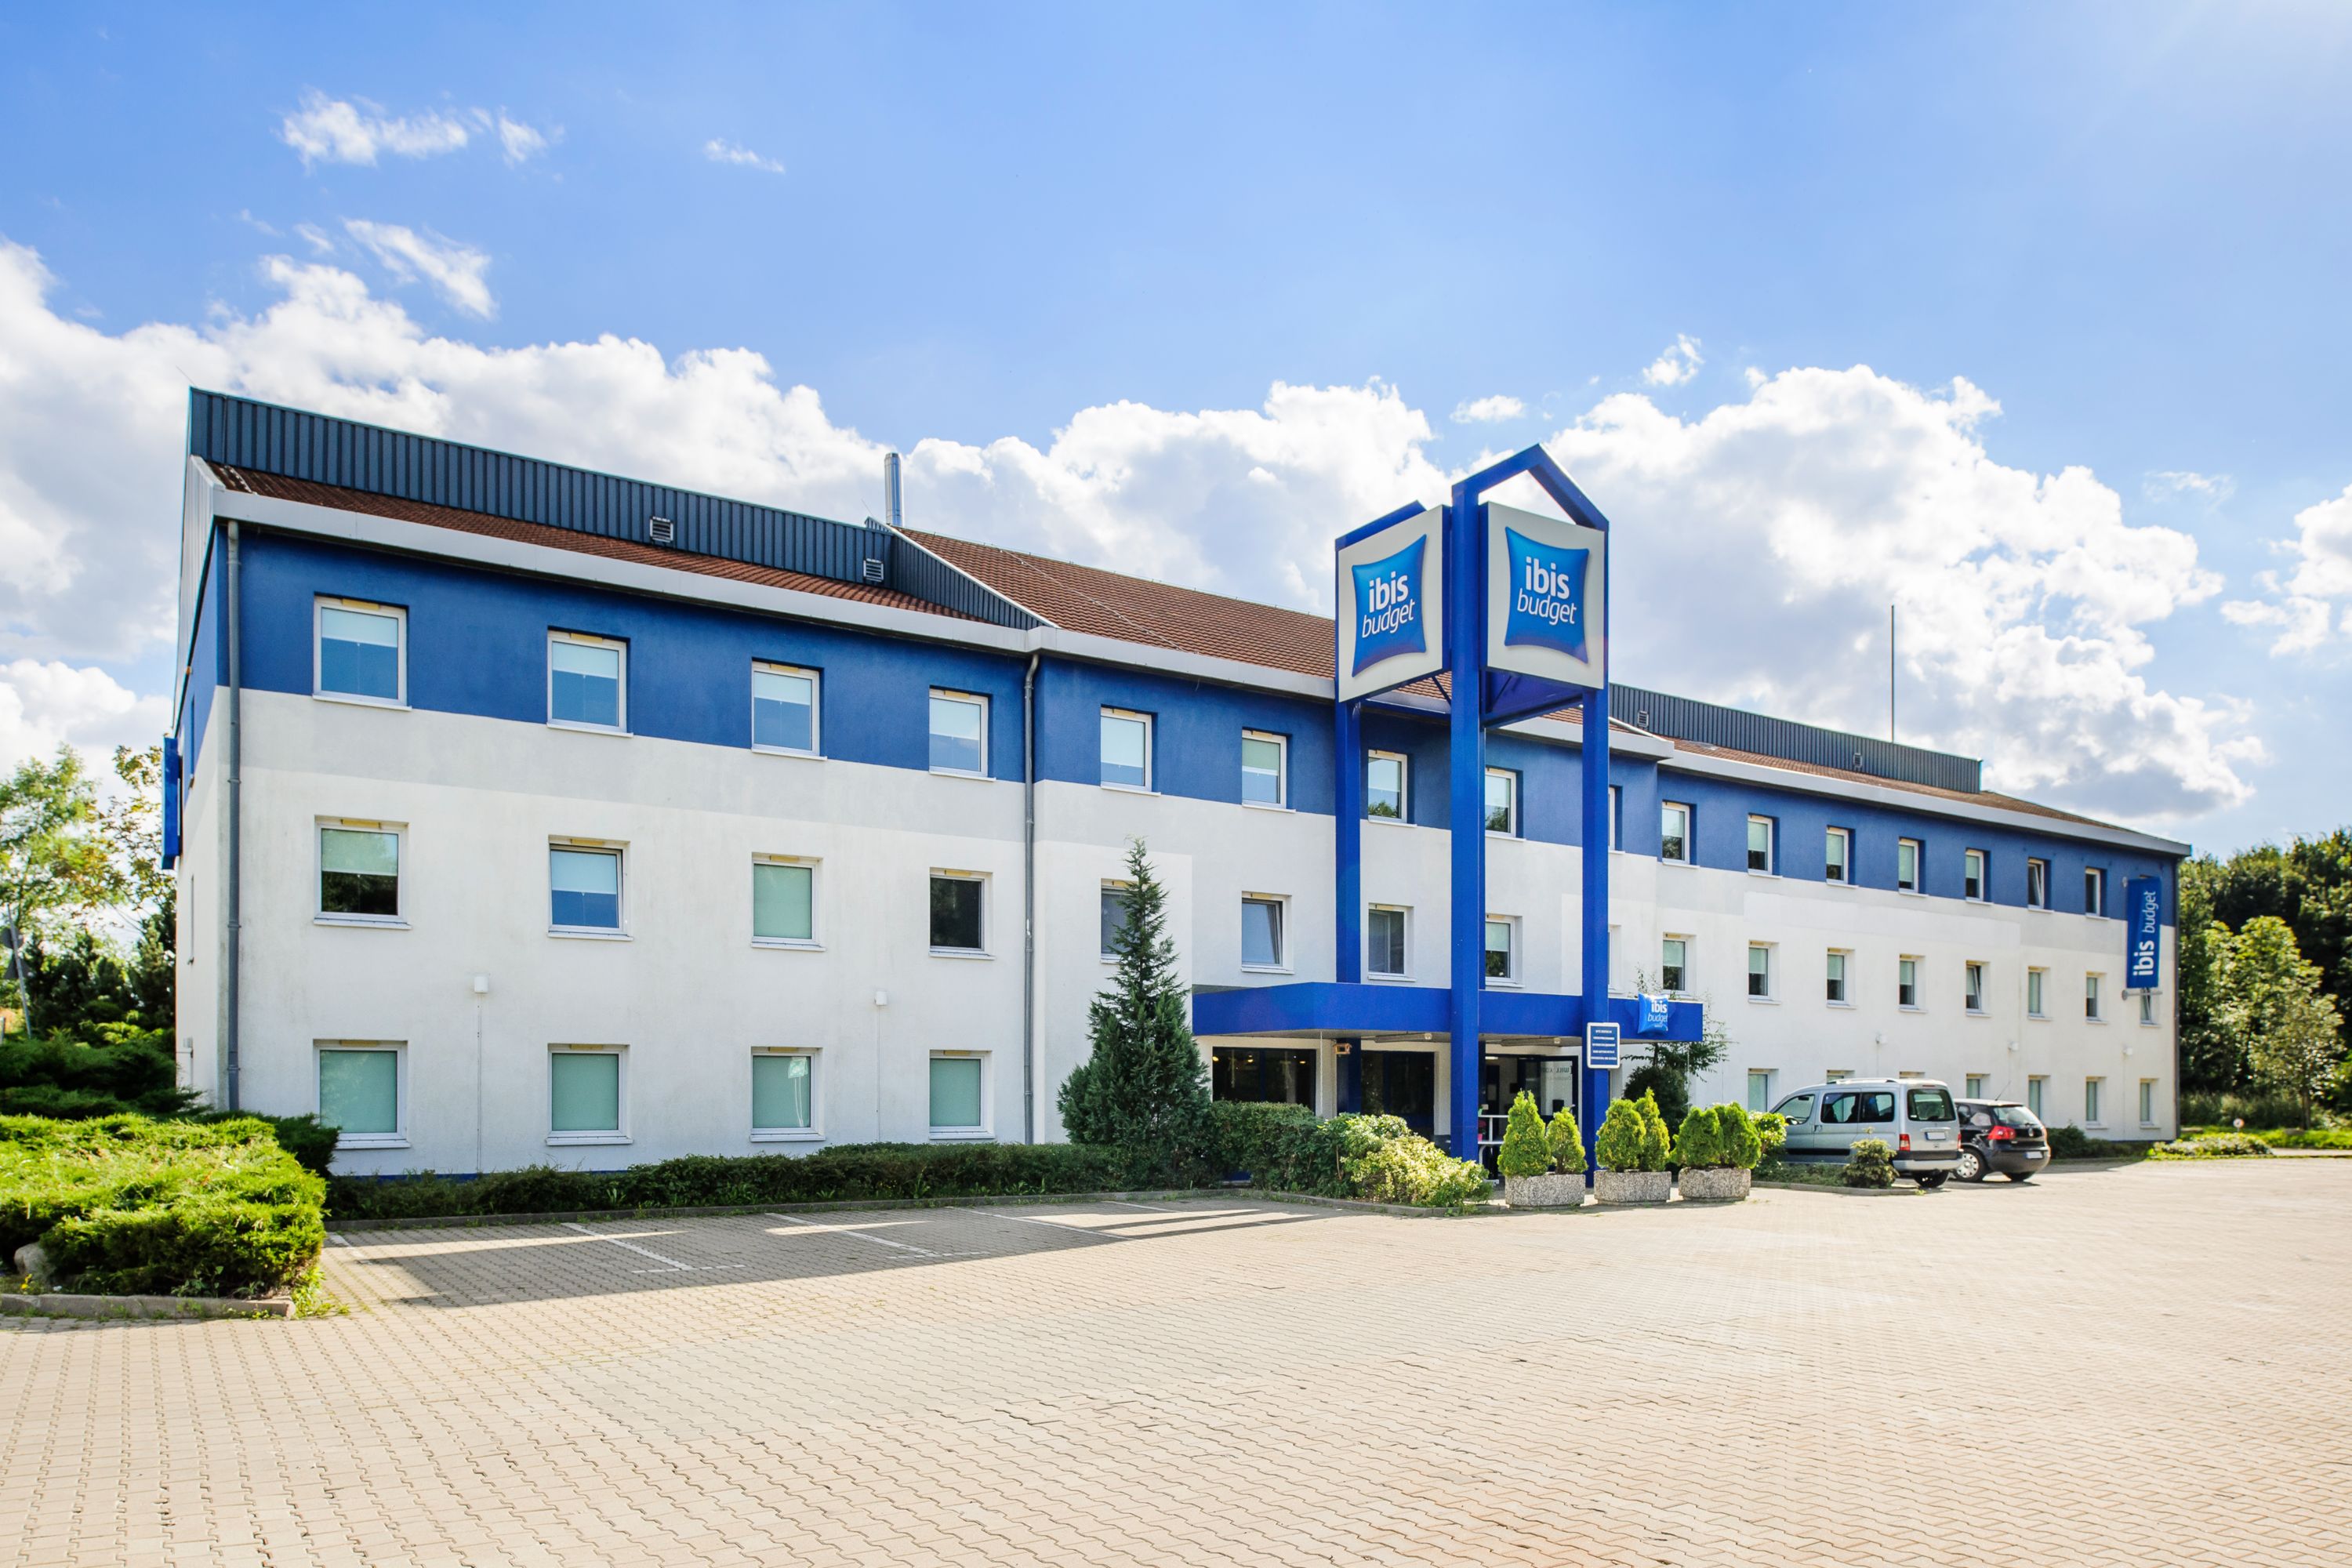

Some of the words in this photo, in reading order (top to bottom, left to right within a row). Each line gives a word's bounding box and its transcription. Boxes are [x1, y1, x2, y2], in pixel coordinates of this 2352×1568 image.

[1368, 571, 1409, 613] ibis
[1526, 556, 1570, 600] ibis
[1362, 598, 1415, 638] budget
[1517, 588, 1577, 626] budget
[2142, 891, 2159, 934] budget
[2132, 940, 2154, 976] ibis
[1651, 1000, 1668, 1014] ibis
